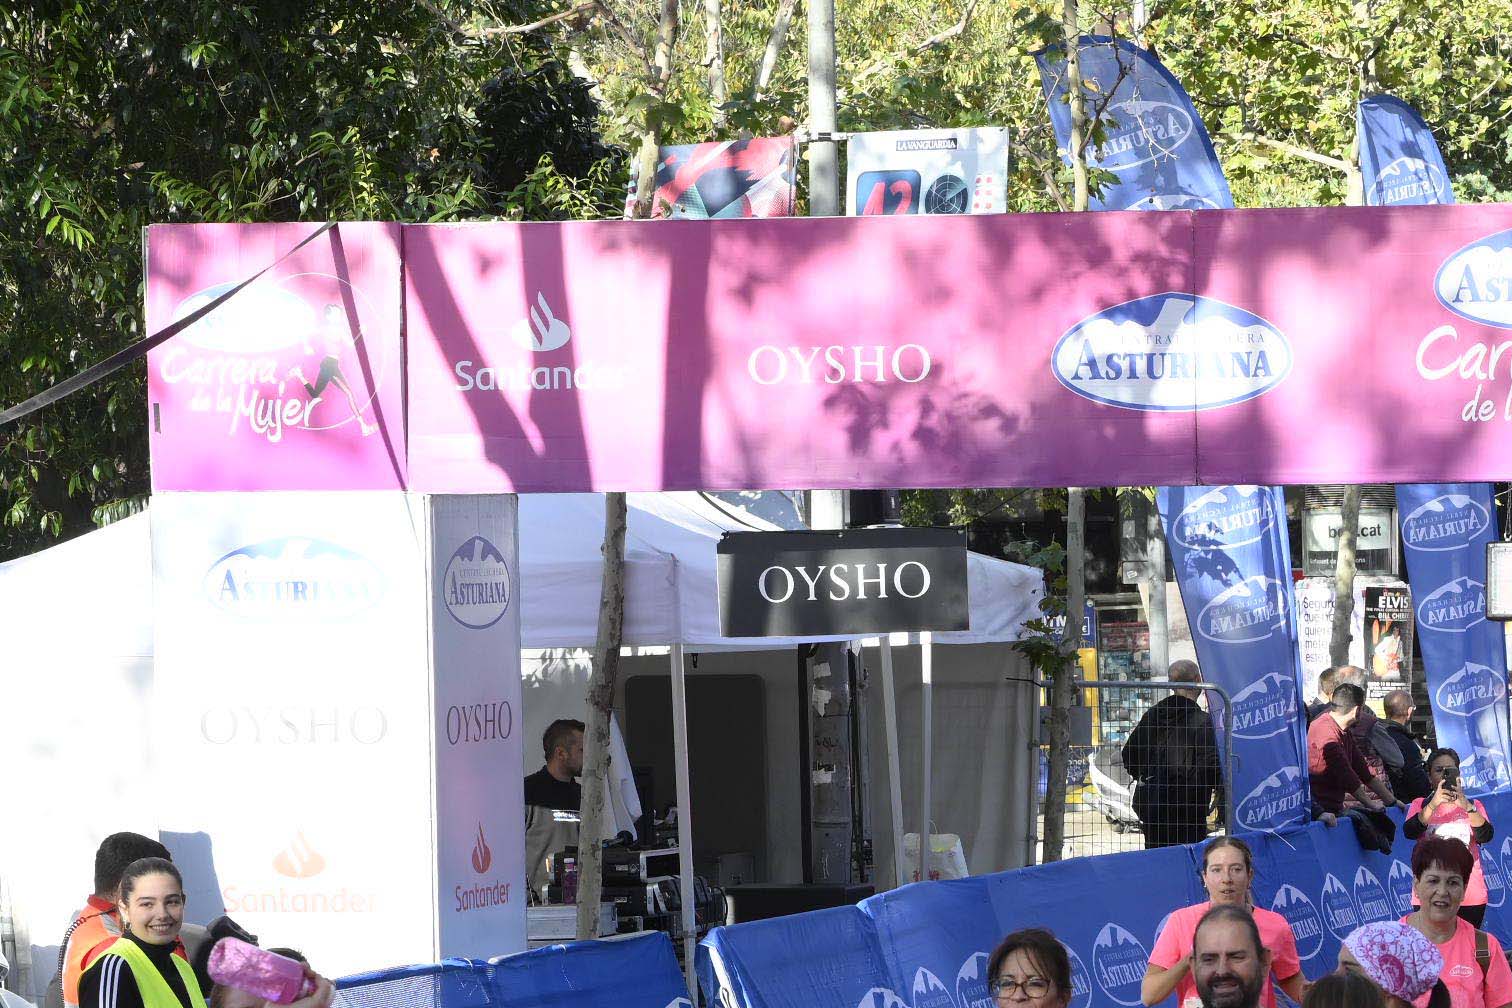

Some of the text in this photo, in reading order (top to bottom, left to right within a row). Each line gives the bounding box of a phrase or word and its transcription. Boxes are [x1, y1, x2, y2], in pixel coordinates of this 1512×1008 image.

[897, 139, 958, 151] LA VANGUARDIA
[747, 343, 932, 386] OYSHO
[229, 378, 324, 442] Mujer
[1461, 384, 1497, 422] de
[448, 572, 508, 607] ASTURIANA
[757, 560, 932, 604] OYSHO
[1379, 596, 1408, 609] ELVIS
[446, 699, 513, 746] OYSHO
[455, 880, 511, 913] Santander
